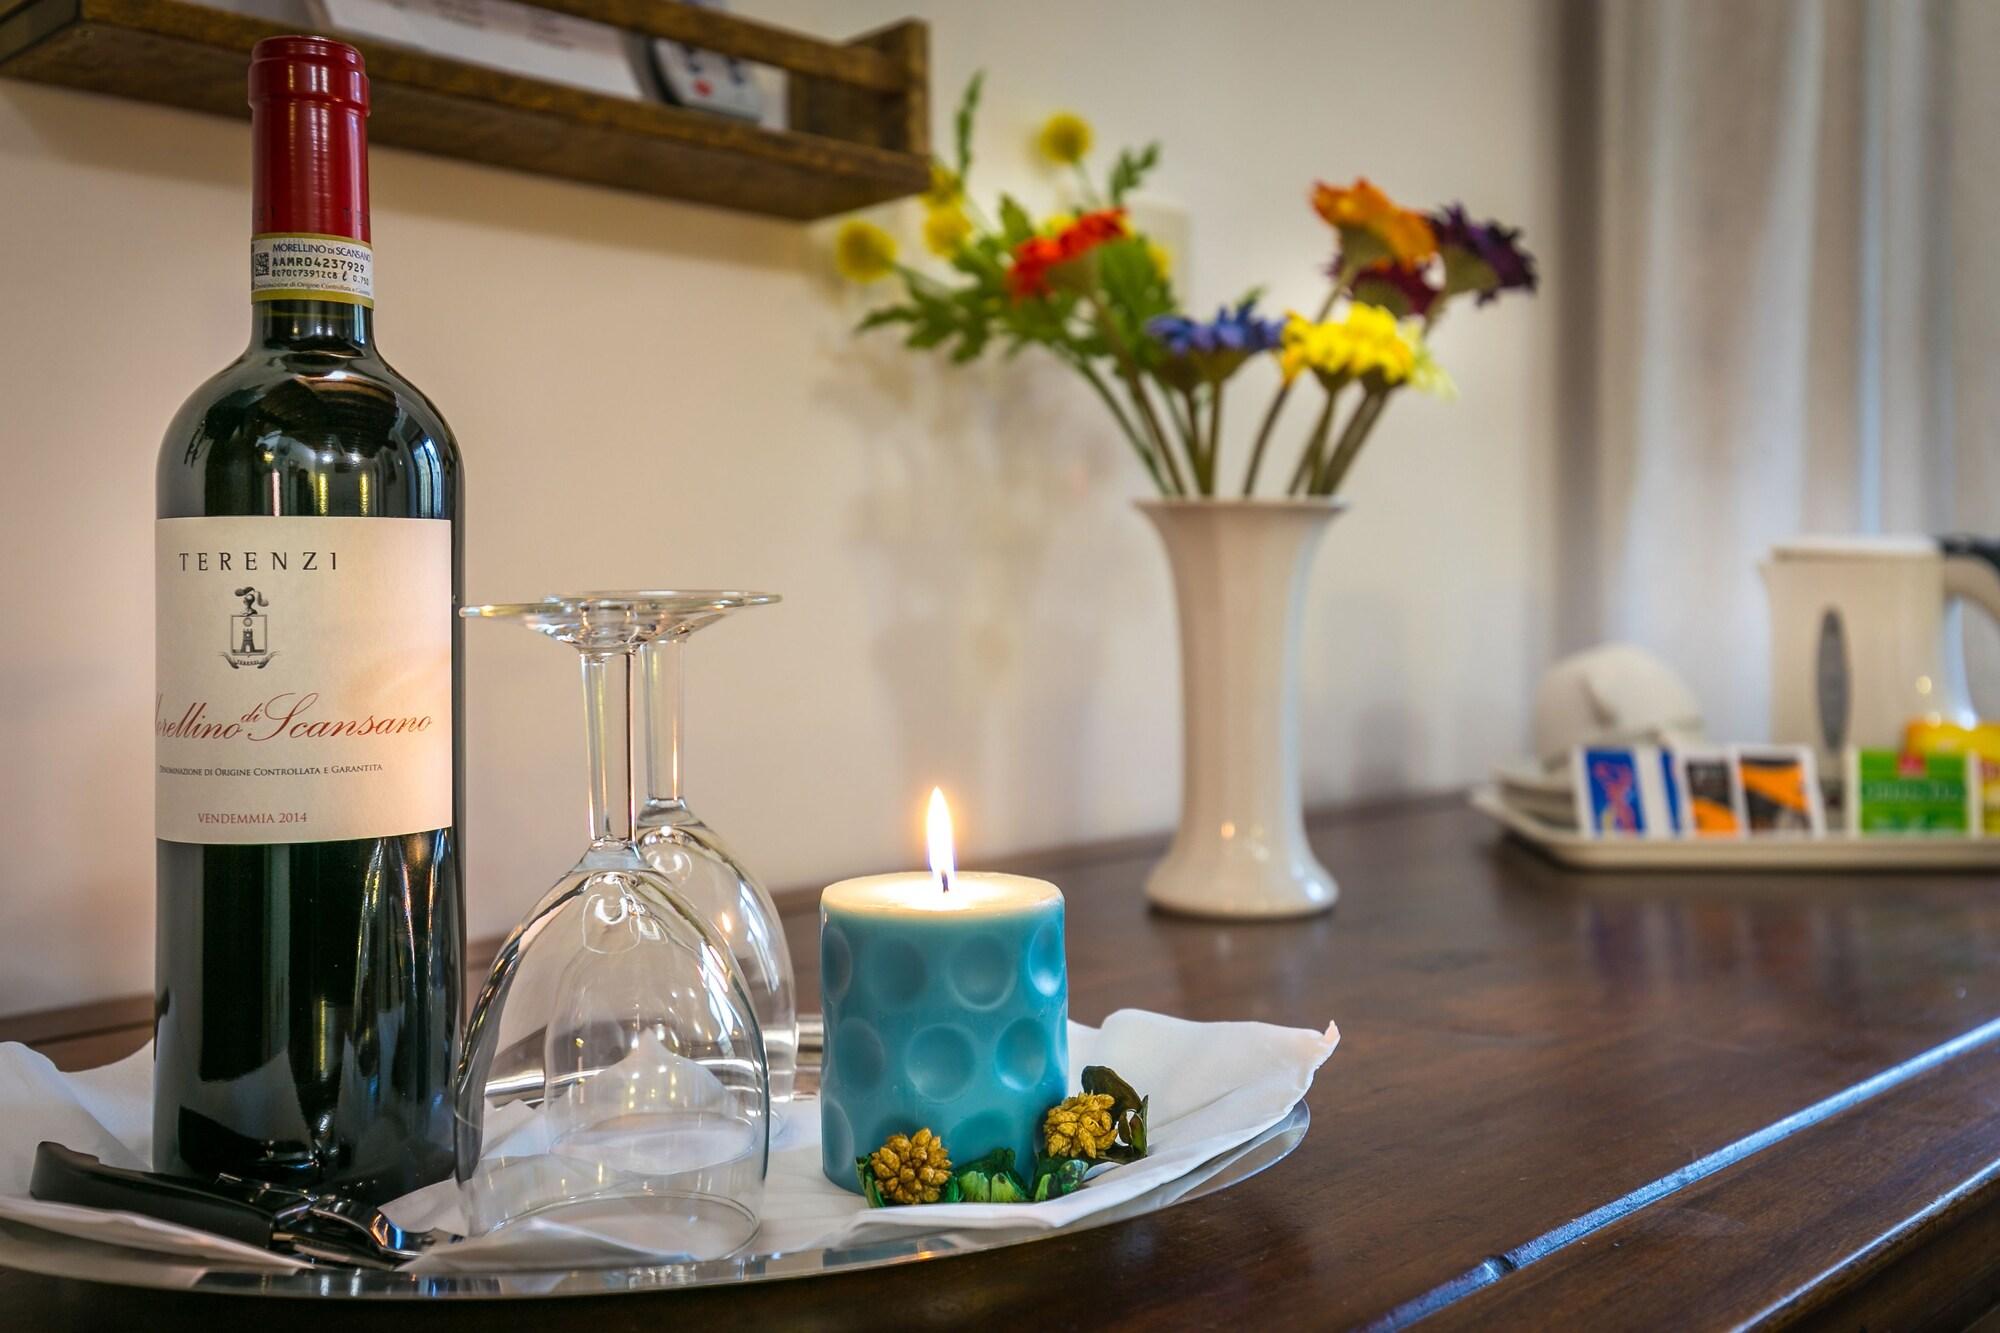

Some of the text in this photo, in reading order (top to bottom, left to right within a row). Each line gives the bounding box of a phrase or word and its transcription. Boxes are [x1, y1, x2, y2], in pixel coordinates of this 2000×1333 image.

[272, 243, 326, 253] MORELLINO
[336, 246, 371, 262] SCANSANO
[179, 551, 337, 572] TERENZI
[155, 692, 433, 742] orellino di Scansano
[204, 768, 213, 776] DI
[214, 767, 251, 776] ORIGINE
[253, 767, 320, 776] CONTROLLATA
[331, 763, 383, 774] GARANTITA
[197, 812, 307, 825] VENDEMMIA 2014
